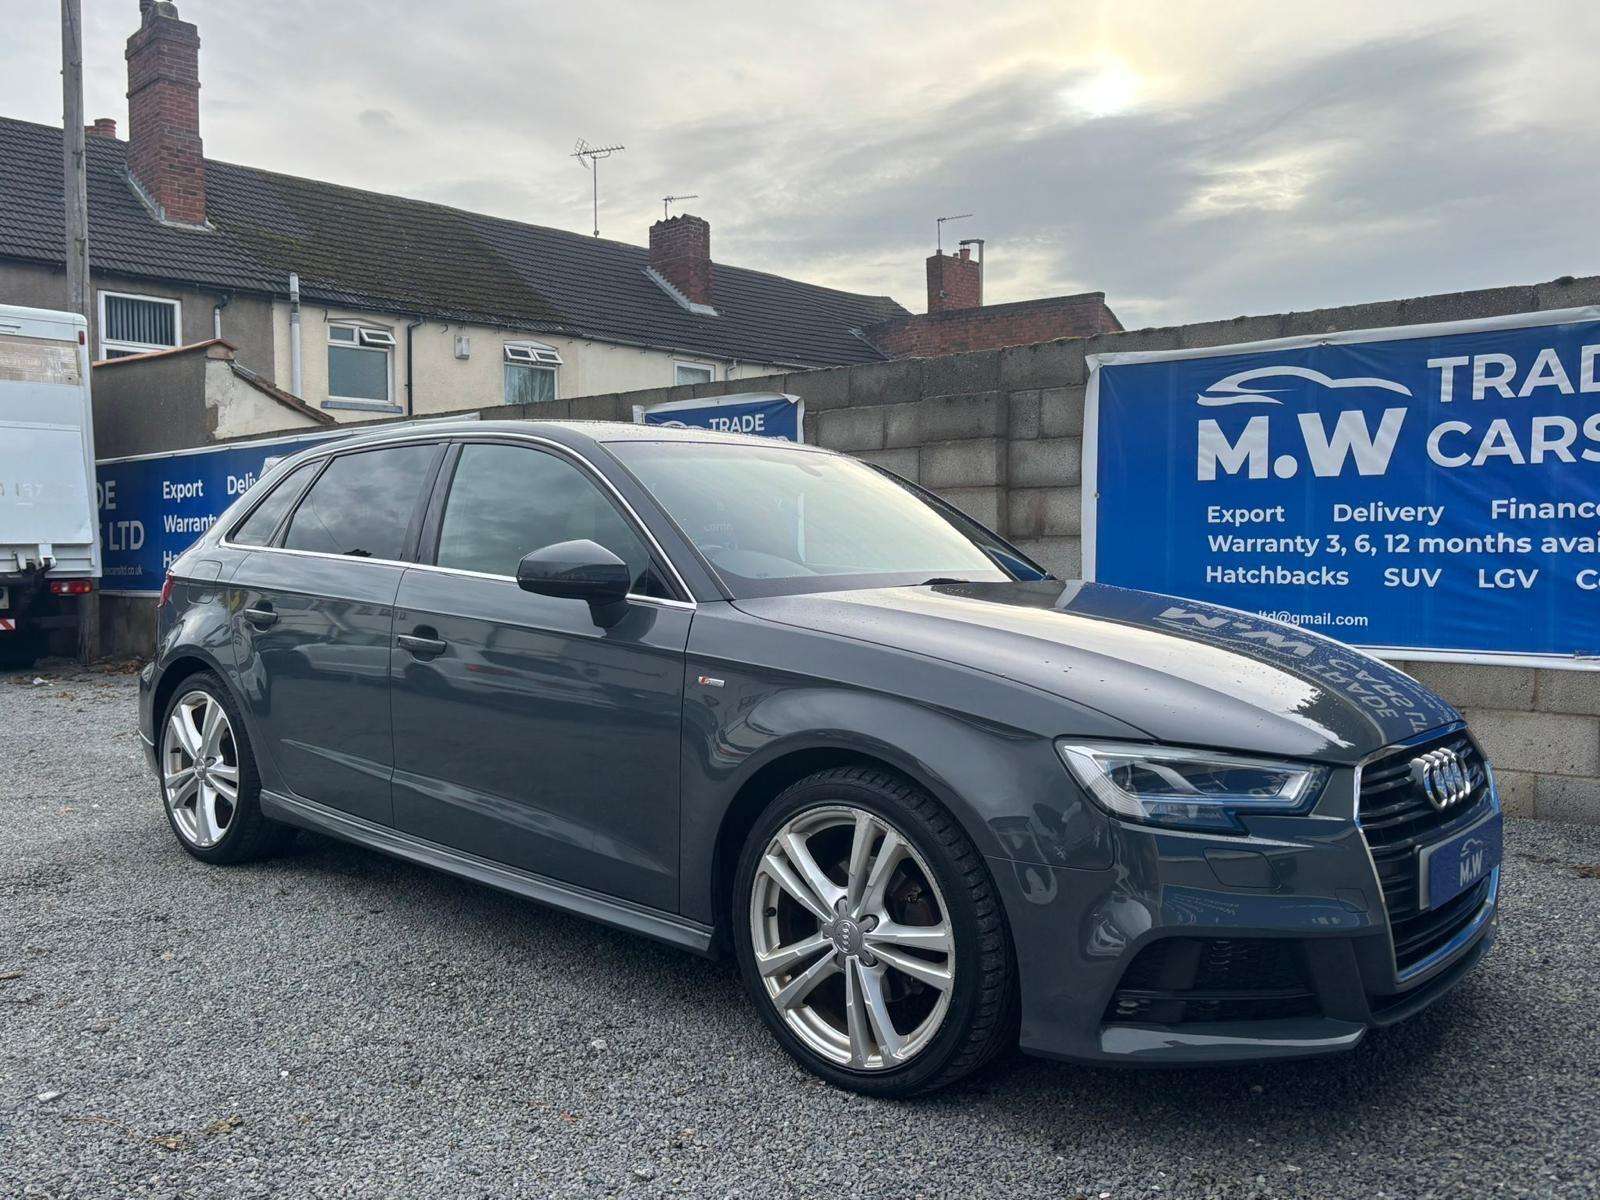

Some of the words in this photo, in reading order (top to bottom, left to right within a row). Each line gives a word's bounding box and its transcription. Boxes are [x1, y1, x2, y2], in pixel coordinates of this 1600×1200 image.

[709, 413, 765, 432] TRADE
[1197, 407, 1408, 481] M.W
[163, 480, 203, 503] Export
[227, 472, 257, 495] Deli
[164, 513, 217, 533] Warrant
[1207, 505, 1285, 527] Export
[1333, 501, 1445, 526] Delivery
[1491, 497, 1600, 520] Financ
[109, 520, 145, 551] LTD
[1208, 534, 1320, 557] Warranty
[1326, 534, 1347, 556] 3,
[1354, 533, 1377, 556] 6,
[1384, 533, 1410, 553] 12
[1418, 532, 1531, 553] months
[1206, 565, 1349, 586] Hatchbacks
[1384, 567, 1442, 588] SUV
[1478, 568, 1538, 589] LGV
[1576, 568, 1600, 590] C
[1460, 850, 1483, 888] M.W
